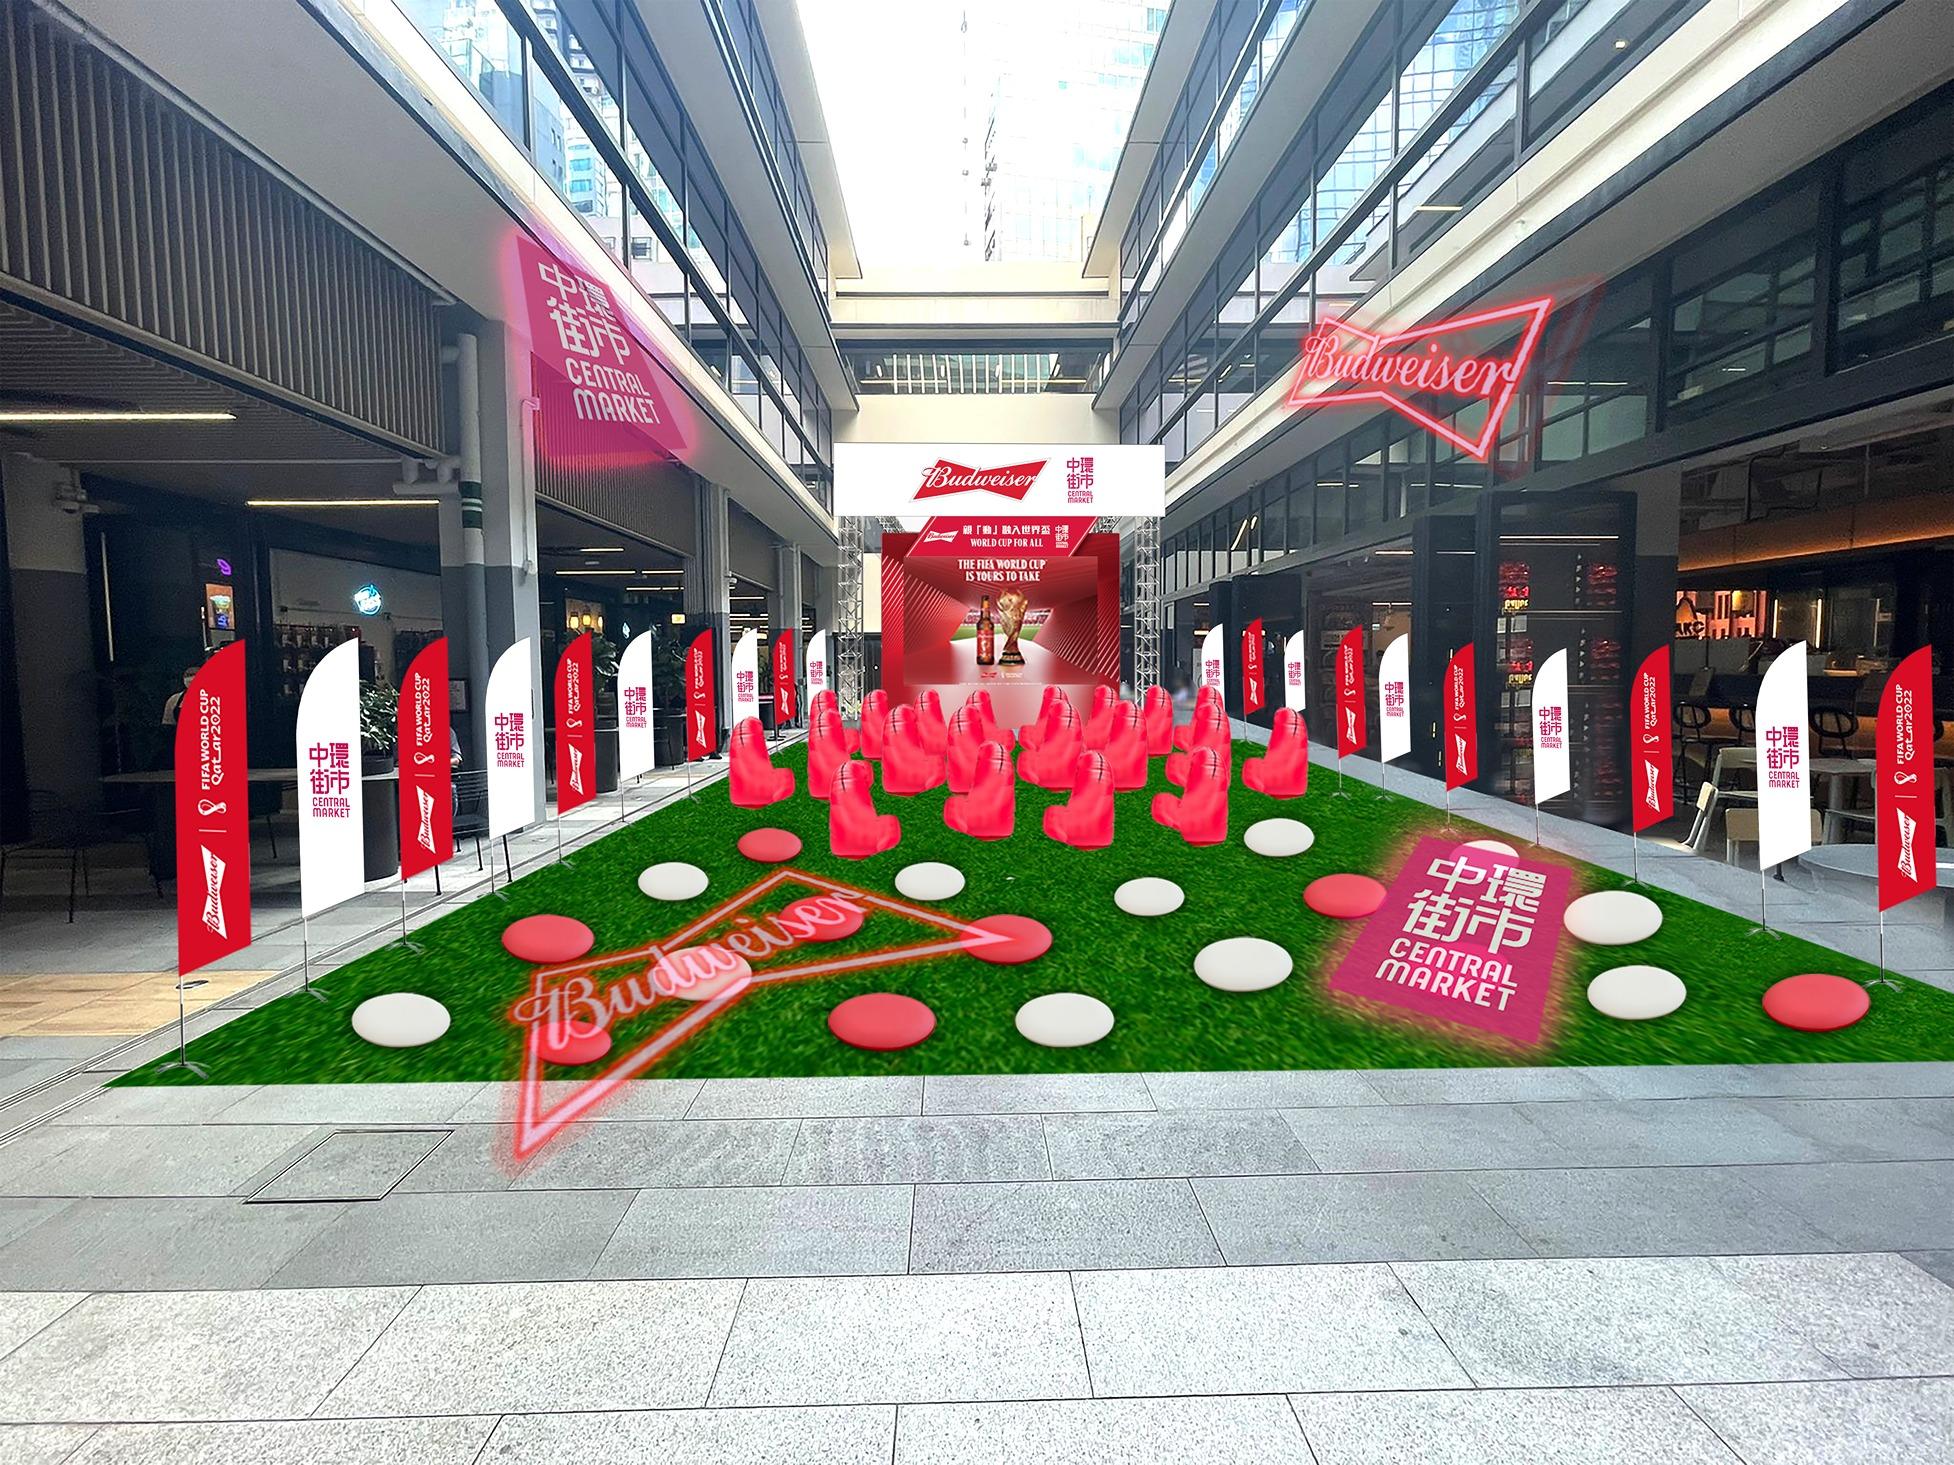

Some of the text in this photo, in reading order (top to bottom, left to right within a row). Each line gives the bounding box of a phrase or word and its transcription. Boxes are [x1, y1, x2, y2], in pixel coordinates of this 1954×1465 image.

[537, 262, 617, 322] 中環
[547, 295, 631, 366] 街市
[1305, 334, 1517, 396] Budweiser
[565, 357, 651, 396] CENTRAL
[572, 387, 661, 425] MARKET
[1066, 456, 1094, 473] 中環
[921, 465, 1036, 488] Budweiser
[1066, 473, 1094, 490] 街市
[970, 538, 1044, 547] WORLD CUP FOR ALL
[958, 559, 975, 570] THE
[993, 559, 1027, 570] WORLD
[1028, 559, 1046, 570] CUP
[965, 571, 1040, 581] IS YOURS TO TAKE
[624, 686, 647, 701] 中環
[1384, 681, 1404, 694] 中環
[625, 701, 647, 715] 街市
[1539, 706, 1561, 721] 中環
[494, 712, 524, 731] 中環
[1540, 721, 1562, 736] 街市
[1895, 684, 1905, 765] FIFA WORLD CUP
[199, 688, 210, 790] FIFA WORLD CUP
[495, 731, 525, 751] 街市
[1765, 726, 1799, 747] 中環
[309, 742, 350, 768] 中環
[496, 752, 525, 760] CENTRAL
[497, 760, 525, 768] MARKET
[1766, 747, 1800, 769] 街市
[310, 768, 350, 795] 街市
[1768, 771, 1800, 780] CENTRAL
[1768, 779, 1800, 788] MARKET
[312, 797, 350, 808] CENTRAL
[312, 807, 351, 818] MARKET
[420, 791, 431, 850] Budweiser
[1901, 814, 1911, 878] Budweiser
[205, 851, 220, 934] Budweiser
[1426, 855, 1547, 914] 中環
[1401, 888, 1536, 955] 街市
[514, 890, 868, 1051] Budweiser
[1388, 936, 1519, 988] CENTRAL
[1374, 957, 1517, 1012] MARKET
